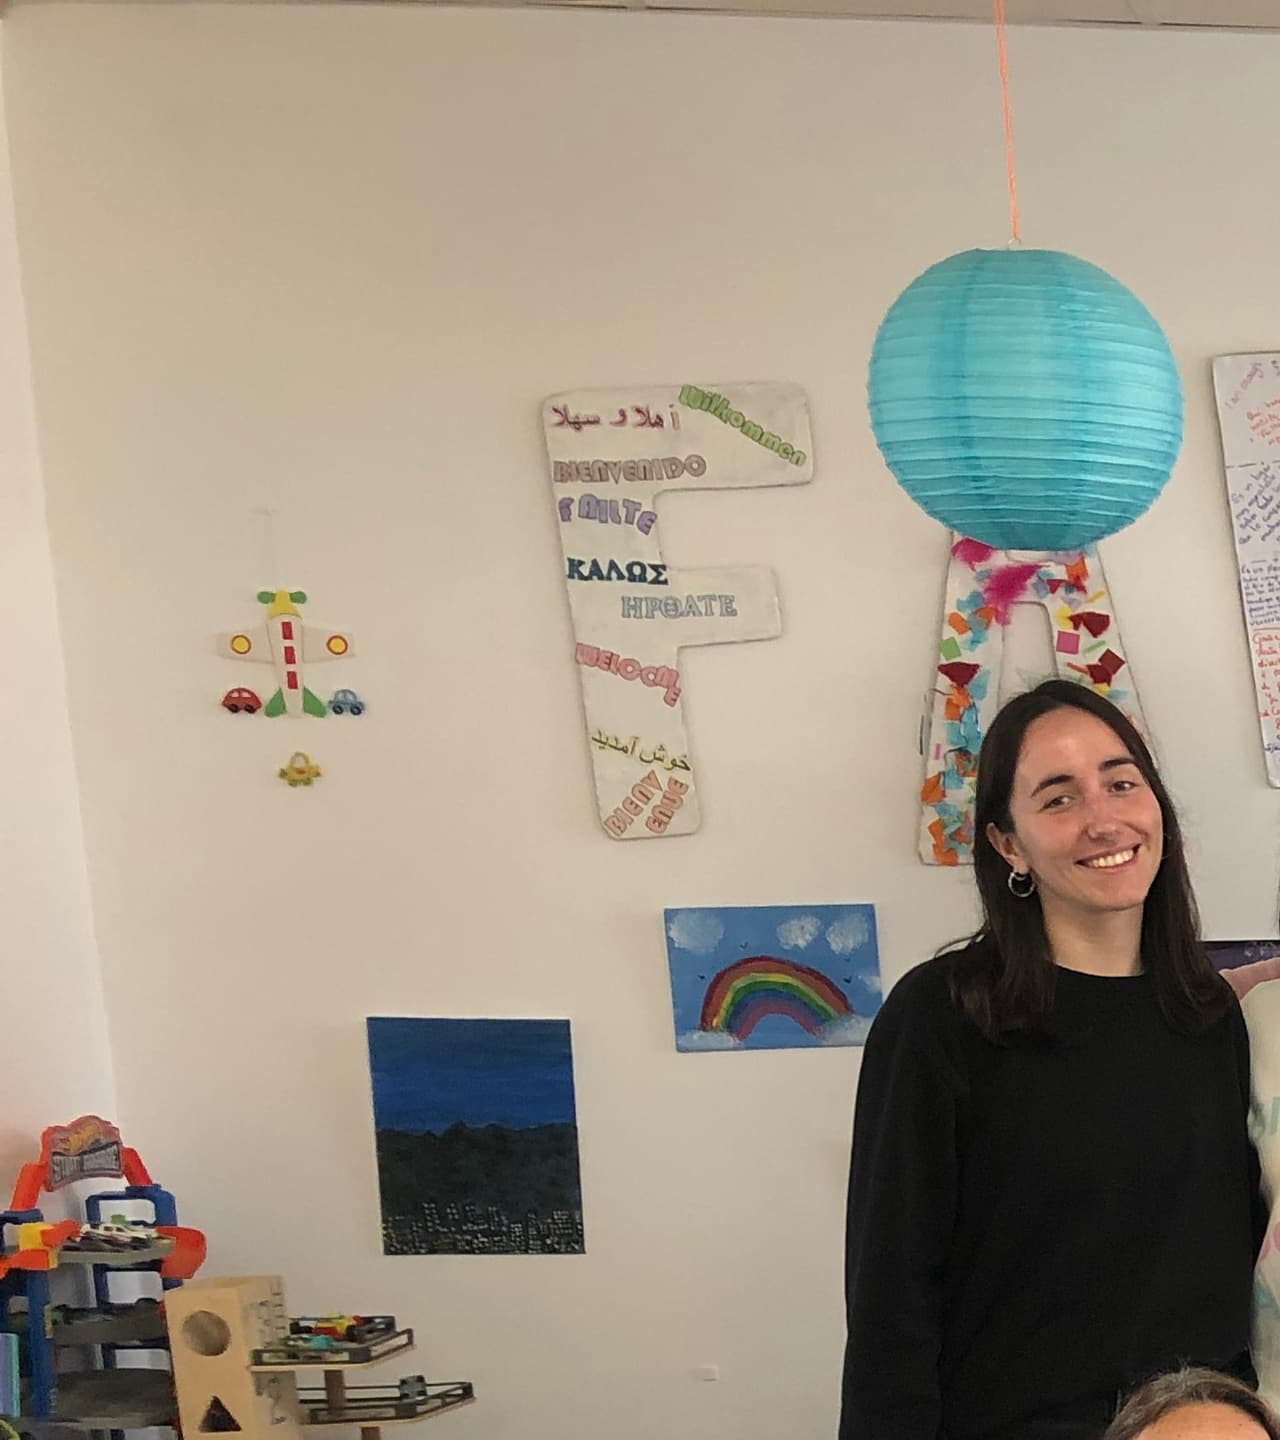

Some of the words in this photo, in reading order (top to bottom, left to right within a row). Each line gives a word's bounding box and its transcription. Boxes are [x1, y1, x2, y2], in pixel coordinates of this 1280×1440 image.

[552, 453, 708, 485] BIENVENIDO
[566, 556, 670, 586] ΚΑΛΩΣ
[620, 593, 739, 620] ΗΡΘΑΤΕ
[574, 642, 683, 708] WELCOME
